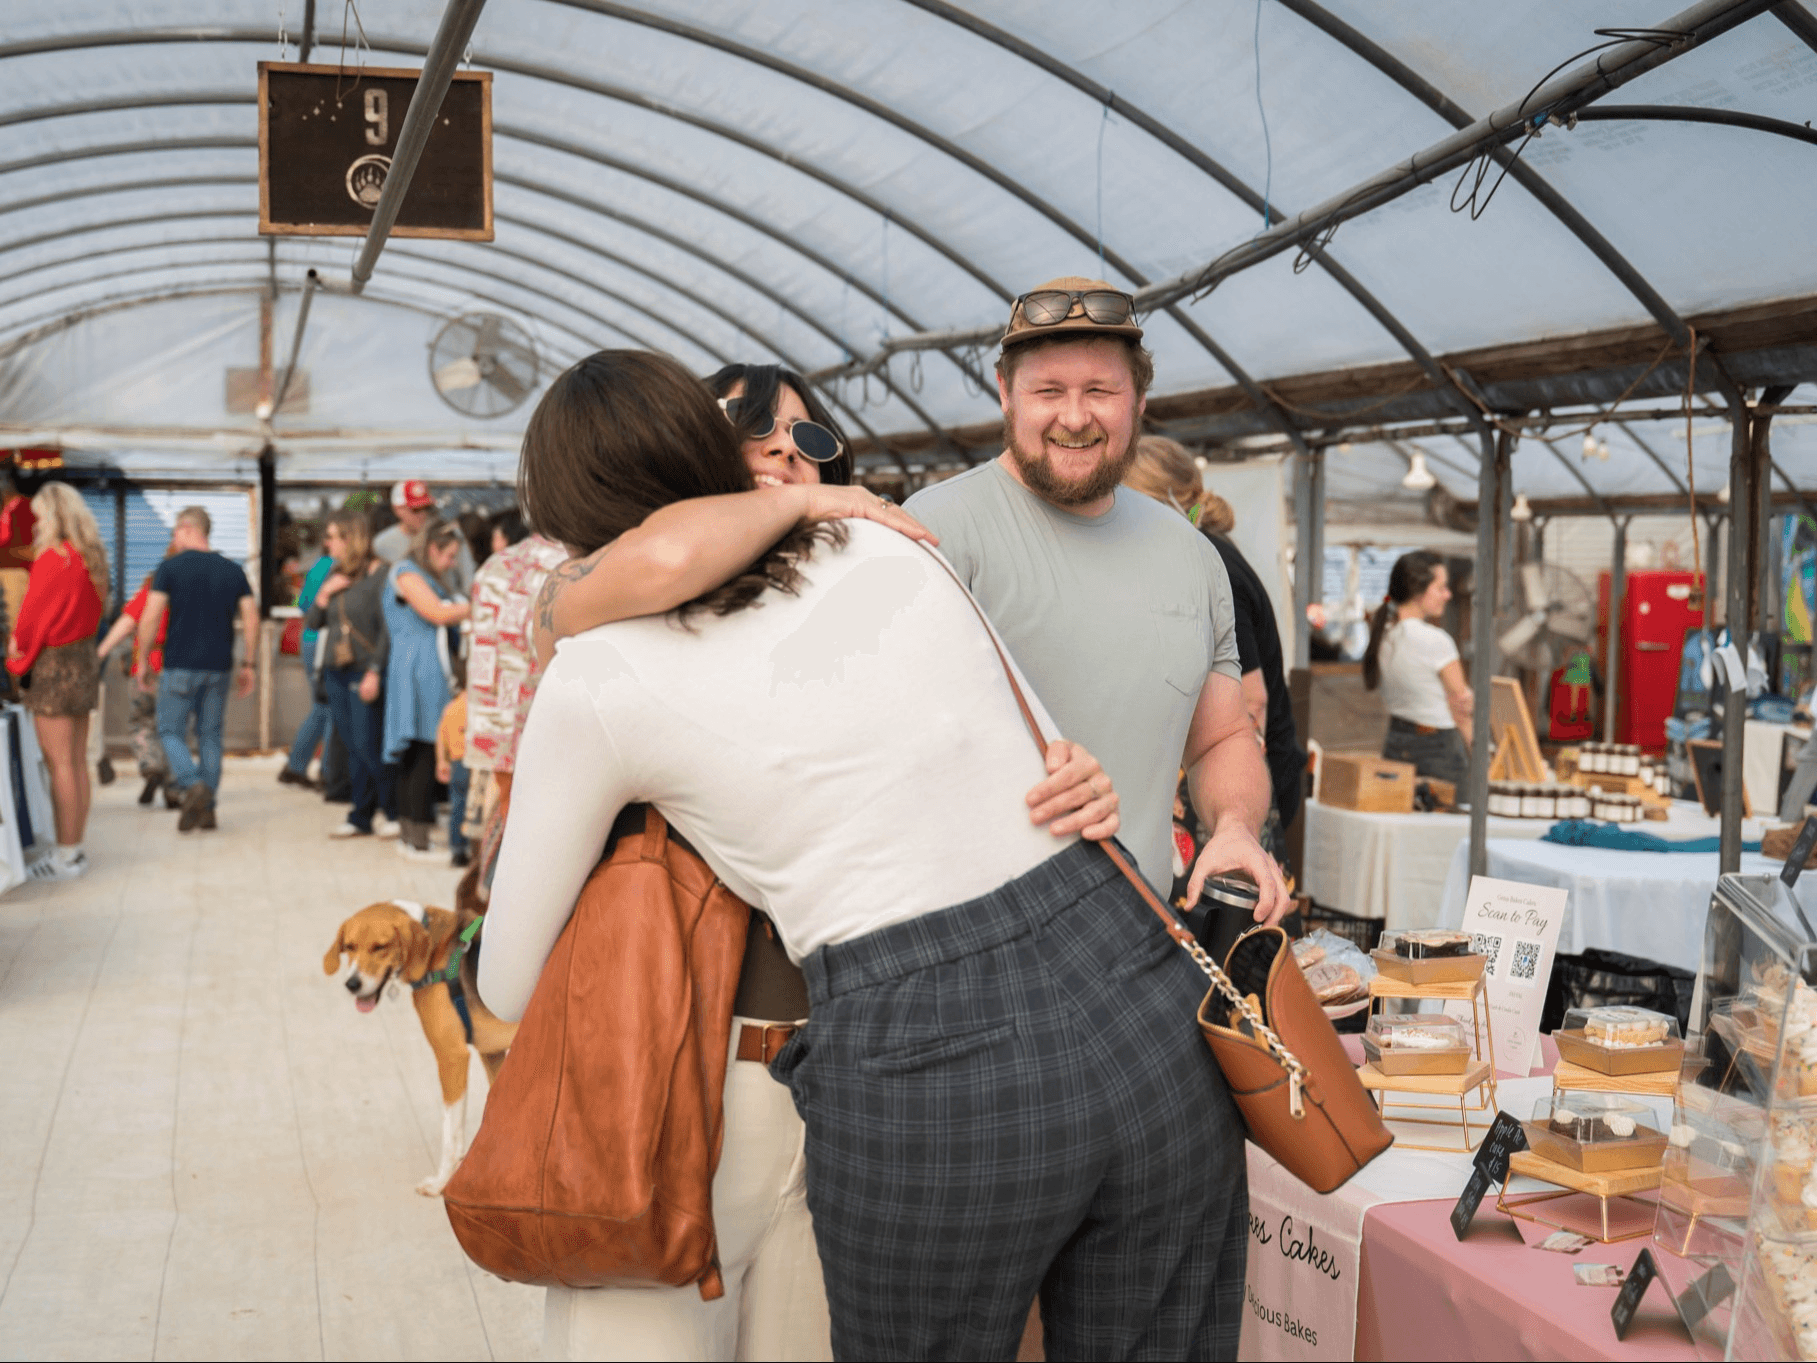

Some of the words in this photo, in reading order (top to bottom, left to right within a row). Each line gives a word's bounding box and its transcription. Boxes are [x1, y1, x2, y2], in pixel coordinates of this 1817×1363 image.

[364, 88, 388, 146] 9
[1478, 902, 1508, 921] Scan
[1509, 910, 1521, 923] to
[1525, 909, 1548, 936] Pay
[1280, 1215, 1341, 1280] Cakes
[1284, 1313, 1318, 1346] Bakes
